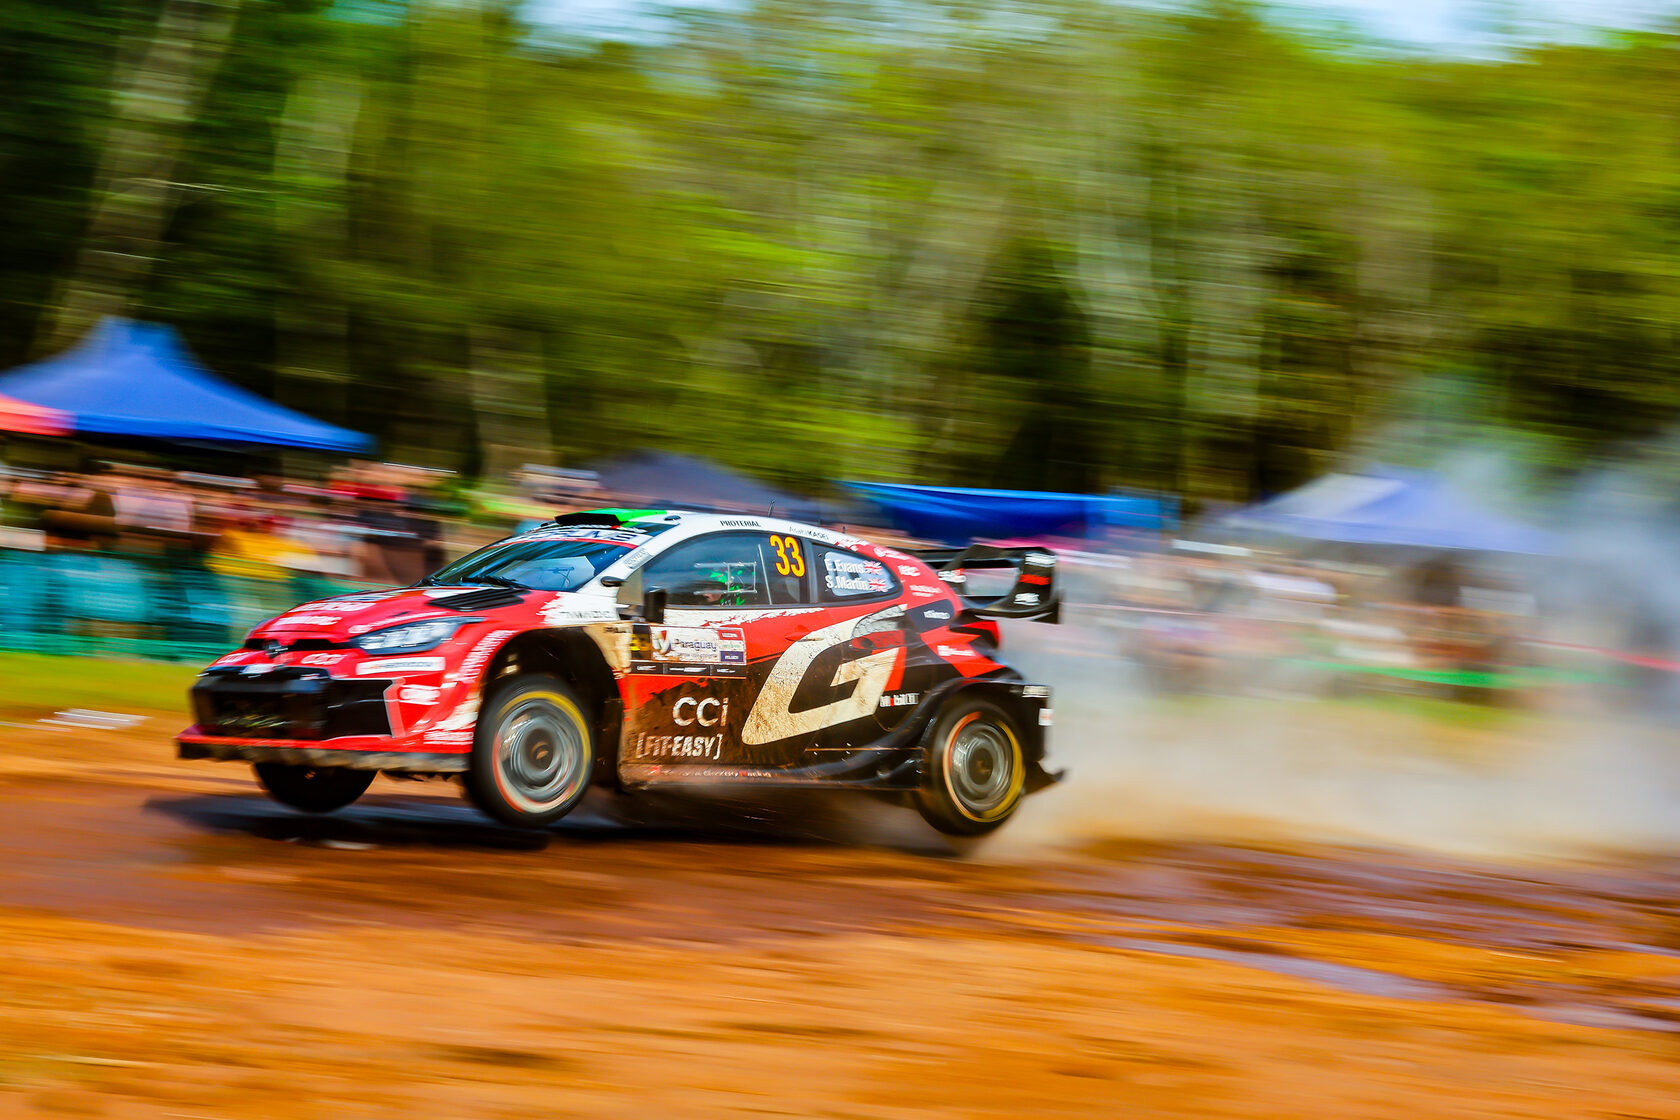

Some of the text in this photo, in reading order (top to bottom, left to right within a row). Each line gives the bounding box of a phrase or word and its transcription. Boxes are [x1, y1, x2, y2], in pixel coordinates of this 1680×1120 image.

[720, 520, 761, 528] PROTERIAL
[769, 534, 806, 577] 33
[824, 558, 865, 574] E.Evans
[825, 574, 870, 591] S.Martin
[675, 638, 717, 652] Paraguay
